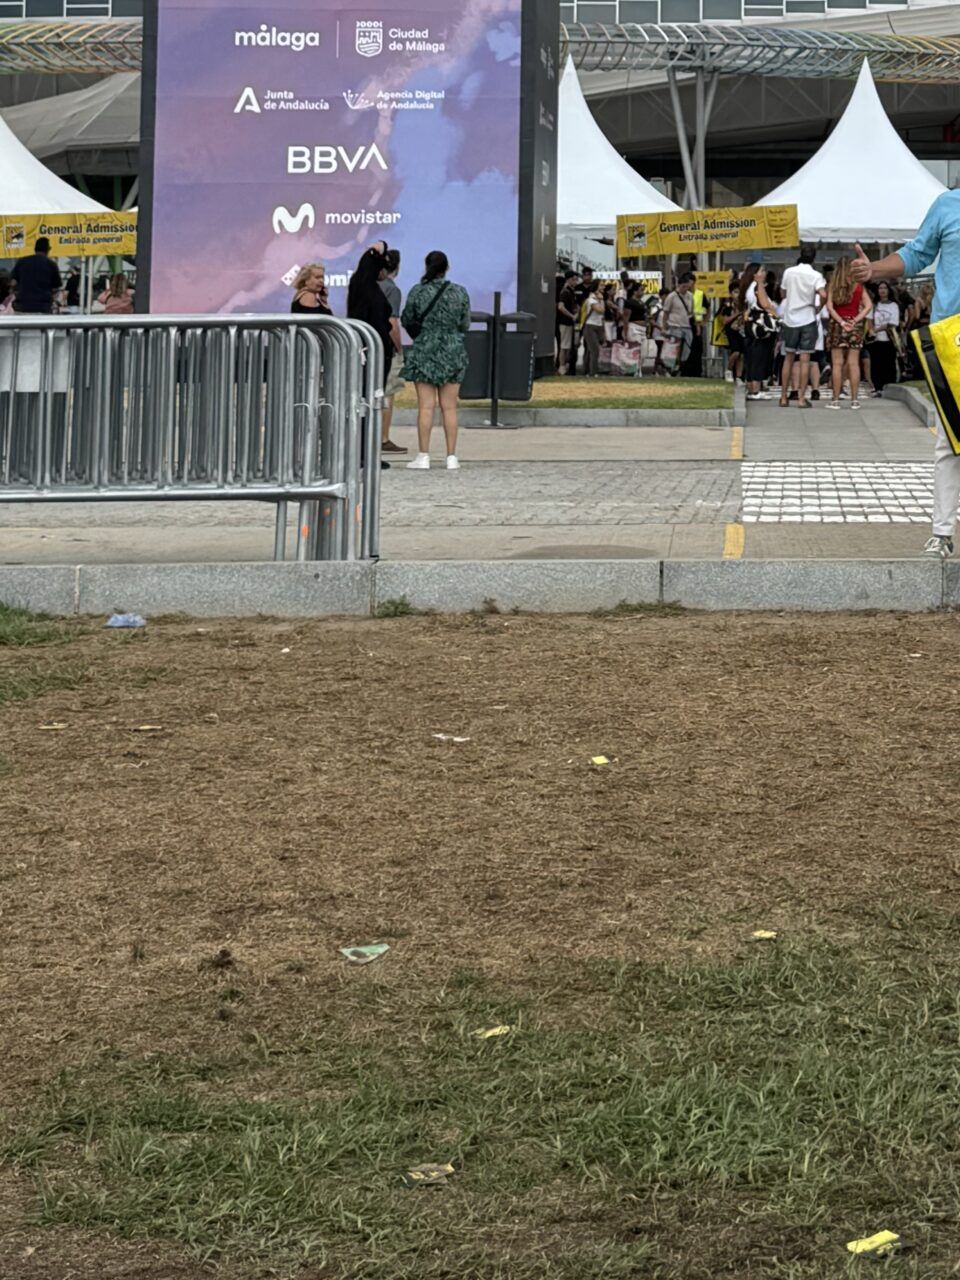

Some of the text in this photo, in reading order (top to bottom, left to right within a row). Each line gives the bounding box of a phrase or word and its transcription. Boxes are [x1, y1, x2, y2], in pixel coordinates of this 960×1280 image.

[389, 28, 429, 39] Ciudad
[389, 40, 445, 53] de Málaga
[264, 90, 294, 99] Junta
[377, 90, 445, 101] Agencia Digital
[264, 99, 329, 110] de Andalucía
[390, 100, 434, 110] Andalucía
[287, 143, 388, 173] BBVA
[325, 210, 402, 224] movistar
[40, 223, 137, 234] General Admissio
[660, 219, 756, 233] General Admission
